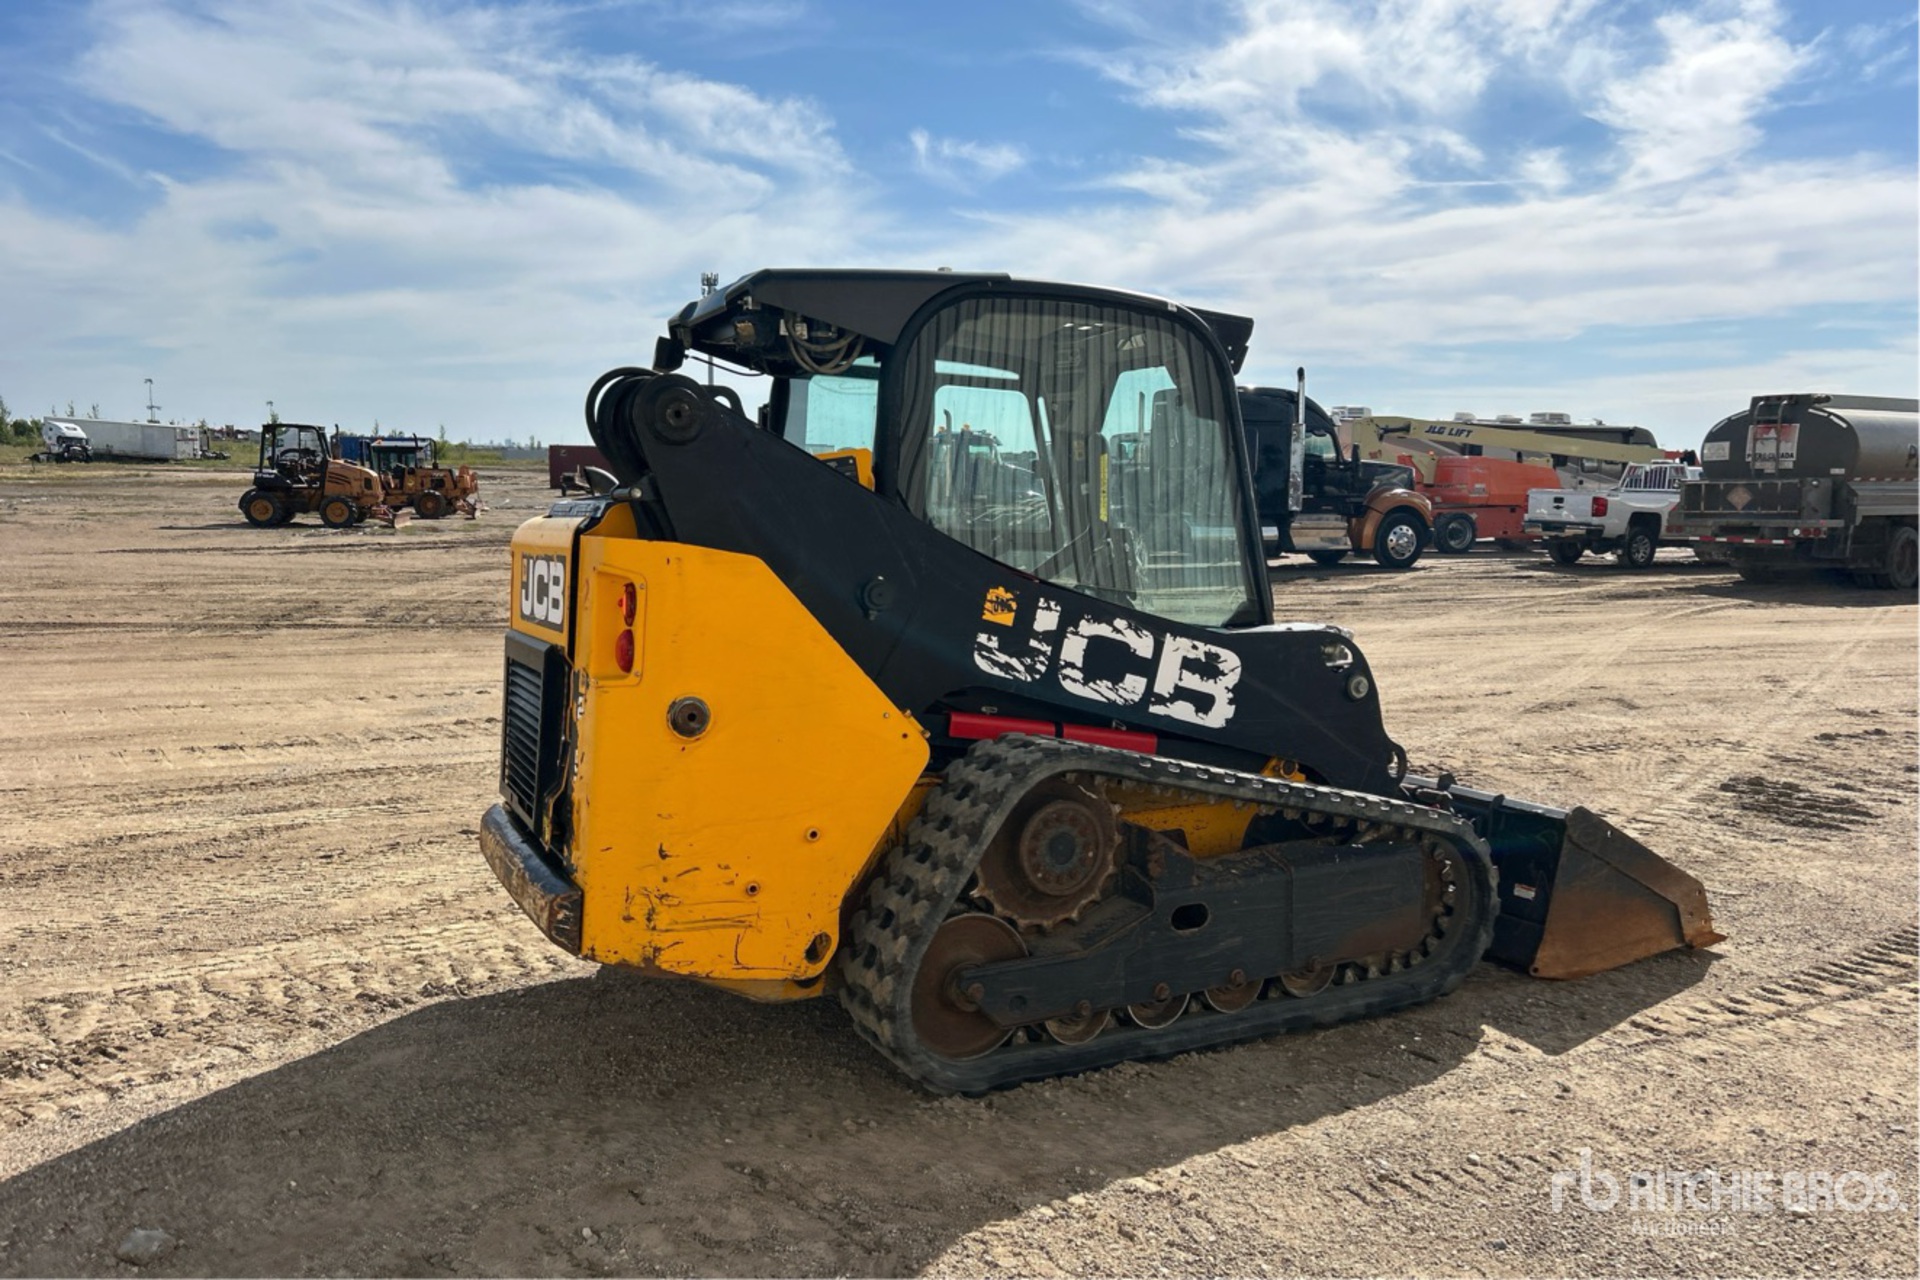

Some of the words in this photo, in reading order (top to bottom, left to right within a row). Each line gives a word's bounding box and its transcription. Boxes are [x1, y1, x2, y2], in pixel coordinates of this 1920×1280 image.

[1424, 425, 1447, 435] JLG
[1447, 427, 1473, 438] LIFT
[521, 558, 565, 625] JCB
[973, 597, 1242, 728] JCB
